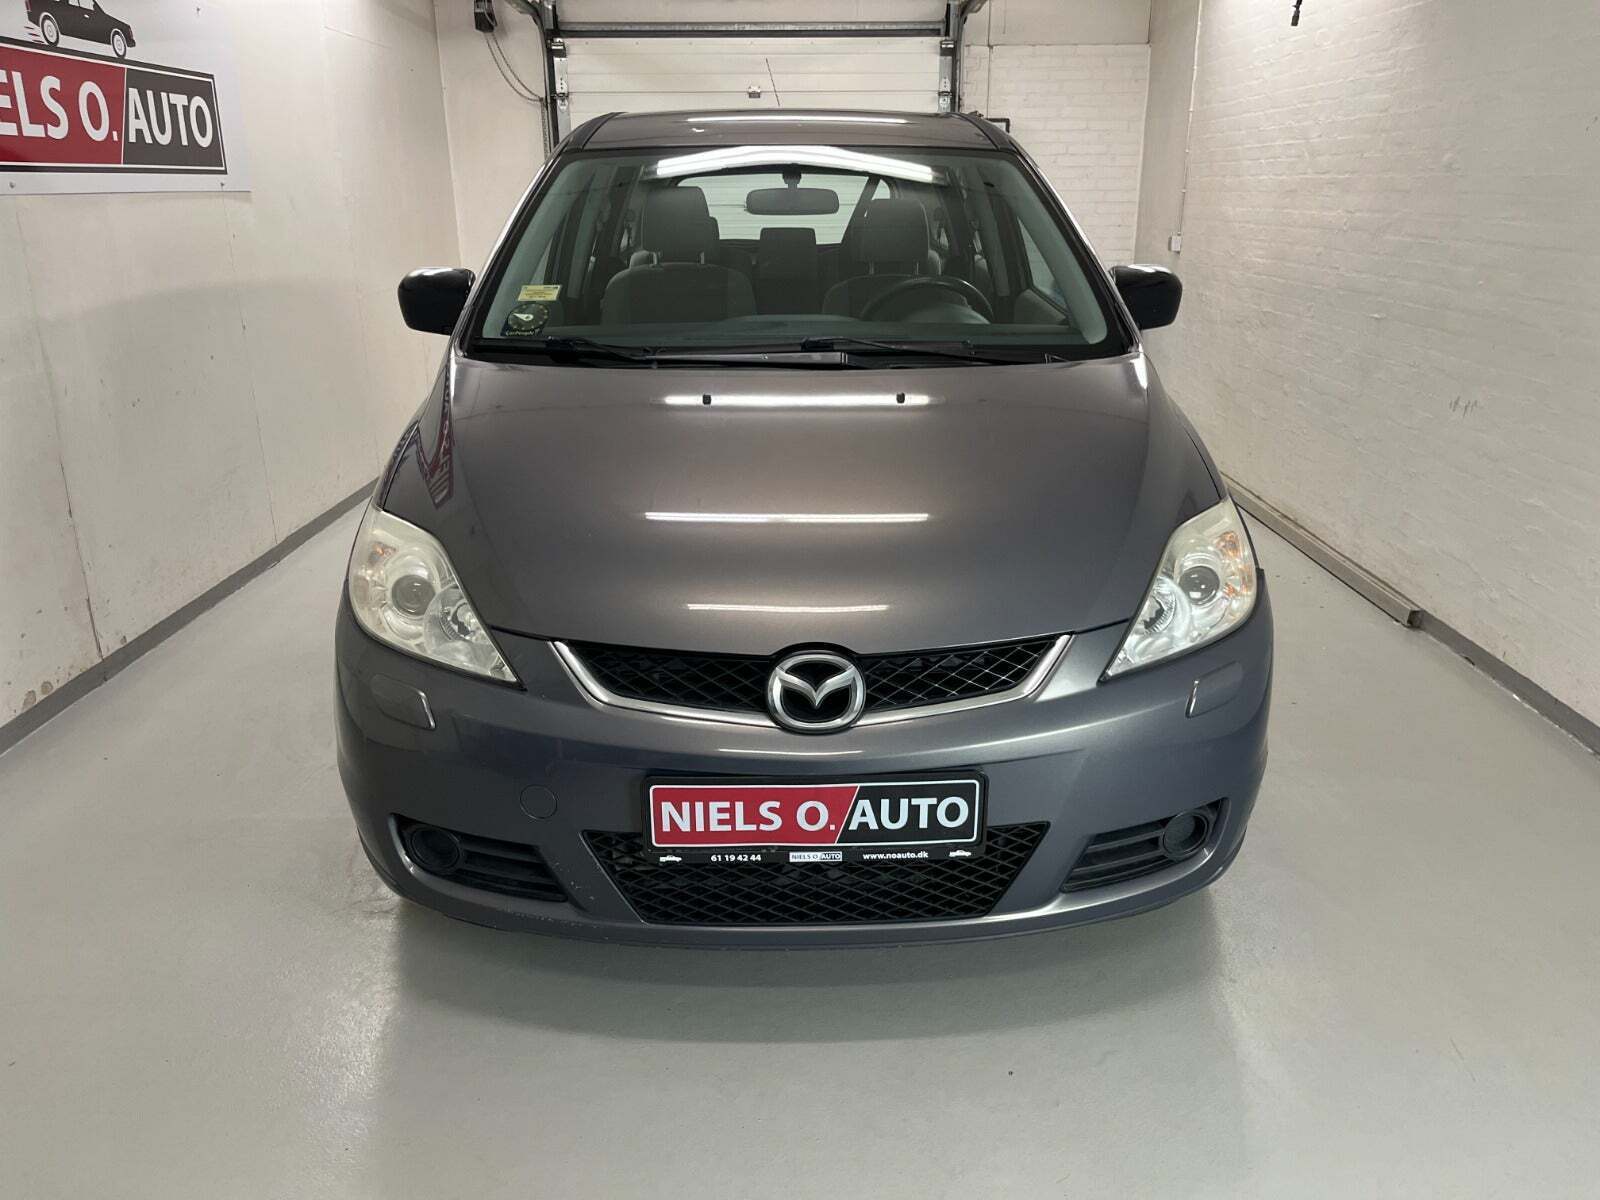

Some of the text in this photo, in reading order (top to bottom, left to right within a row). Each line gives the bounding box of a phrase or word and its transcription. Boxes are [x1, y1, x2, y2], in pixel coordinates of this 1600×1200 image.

[78, 80, 118, 142] O.
[128, 87, 214, 148] AUTO
[661, 796, 969, 832] NIELS O. AUTO
[710, 854, 762, 862] 61 19 42 44
[821, 852, 841, 860] AUTO
[862, 850, 929, 860] www.noauto.dk
